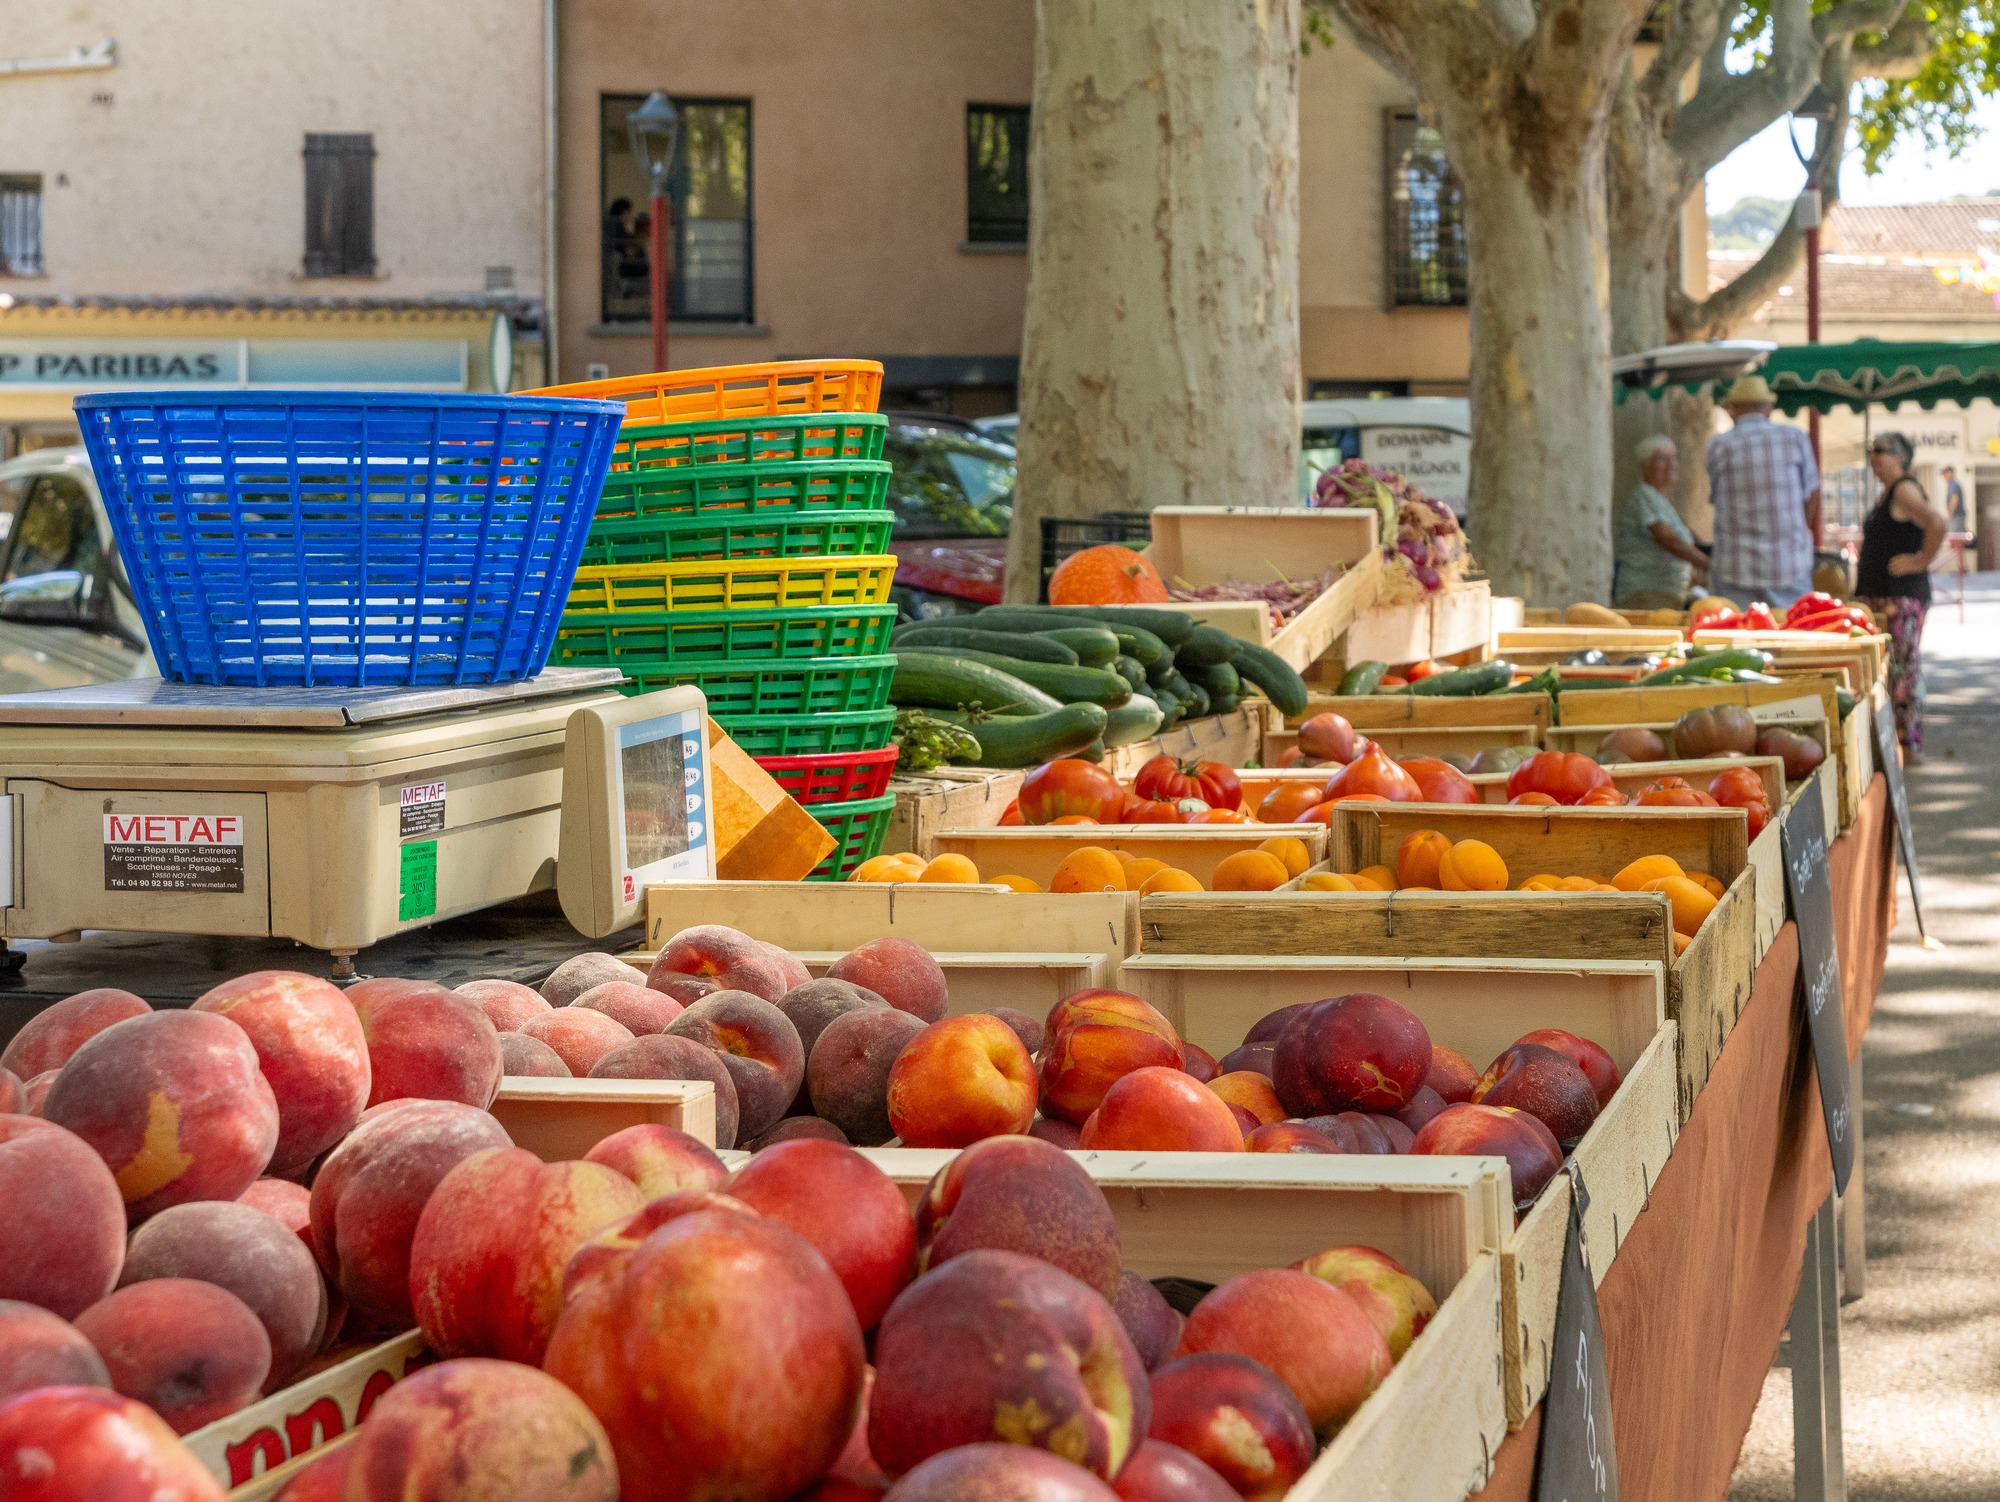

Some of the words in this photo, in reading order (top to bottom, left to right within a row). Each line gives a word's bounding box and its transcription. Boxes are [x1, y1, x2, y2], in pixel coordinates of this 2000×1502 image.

[36, 352, 220, 377] PARIBAS
[1377, 432, 1452, 448] DOMAINE
[685, 744, 692, 754] kg
[402, 783, 445, 805] METAF
[688, 798, 694, 809] €
[110, 816, 237, 843] METAF
[111, 846, 135, 854] Vente
[144, 846, 190, 856] Réparation
[199, 847, 237, 855] Entretien
[125, 855, 166, 864] comprimé
[174, 856, 237, 864] Banderoleuses
[127, 863, 181, 872] Scotcheuses
[189, 864, 222, 873] Pesage
[151, 872, 172, 880] 13550
[111, 879, 127, 887] Tél.
[128, 879, 138, 887] 04
[164, 880, 174, 888] 98
